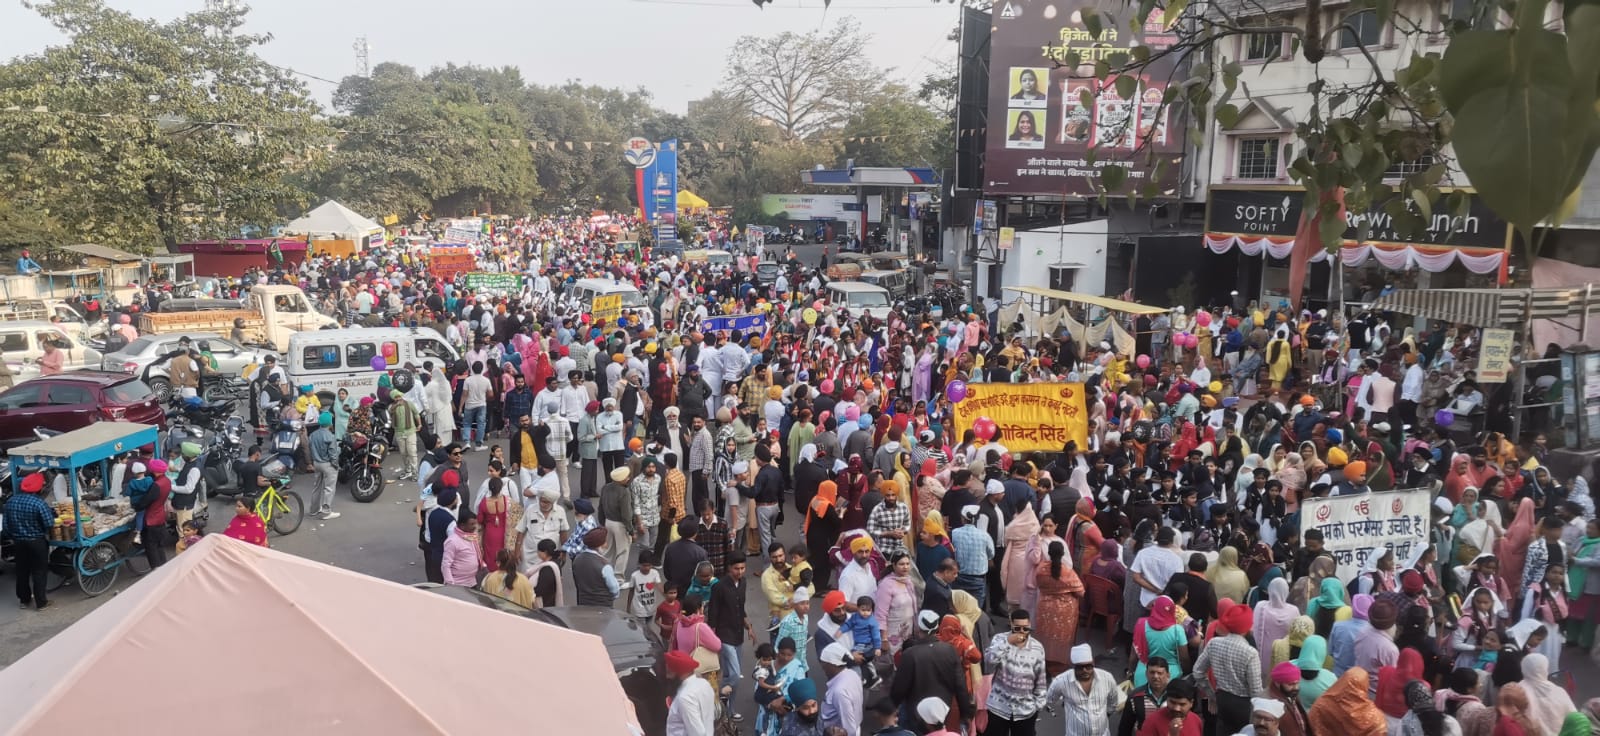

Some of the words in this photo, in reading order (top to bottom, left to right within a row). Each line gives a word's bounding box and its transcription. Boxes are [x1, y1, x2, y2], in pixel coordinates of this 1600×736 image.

[1109, 28, 1119, 42] ने
[1234, 205, 1290, 222] SOFTY
[1243, 222, 1277, 232] POINT
[1367, 230, 1438, 242] BAKY
[1040, 423, 1066, 443] सिंह
[639, 583, 645, 594] I
